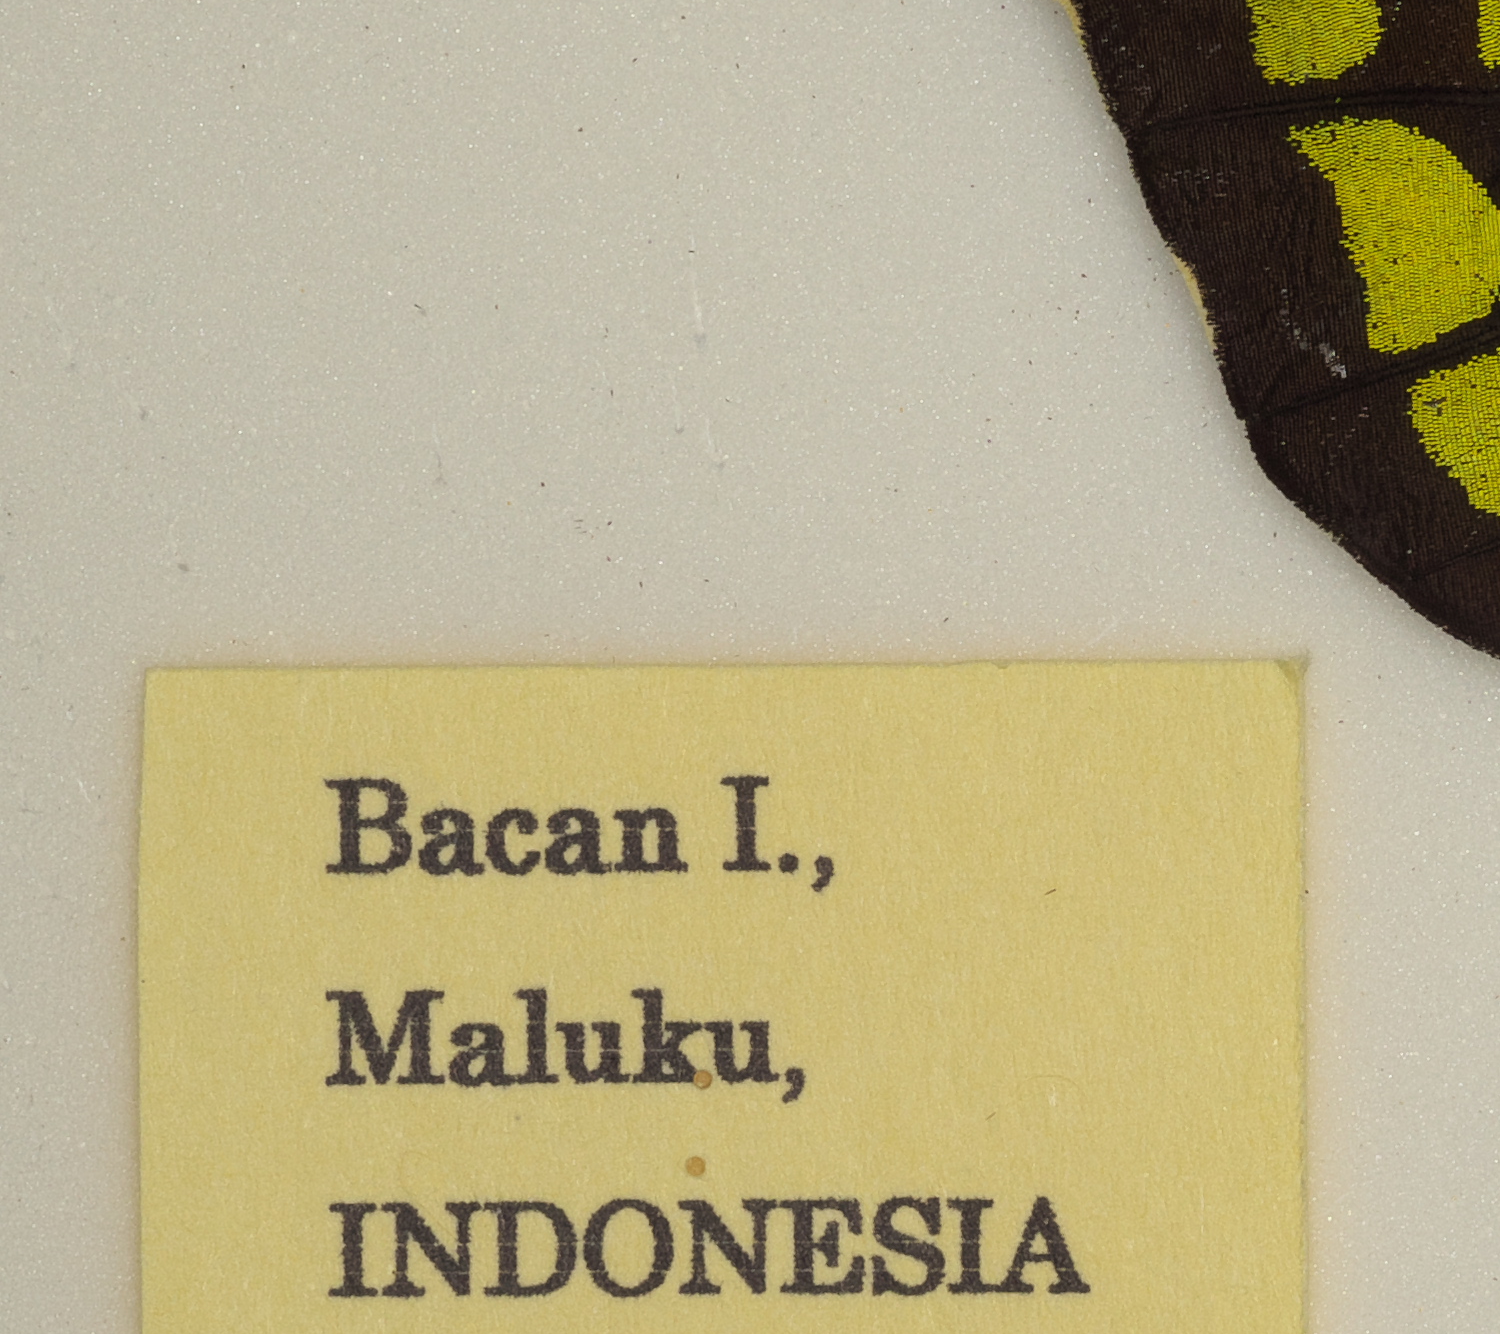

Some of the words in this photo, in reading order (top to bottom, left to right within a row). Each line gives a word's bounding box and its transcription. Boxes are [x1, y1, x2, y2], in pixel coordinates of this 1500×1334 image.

[324, 776, 689, 878] Bacan
[719, 774, 835, 893] I.,
[324, 987, 806, 1103] Maluku,
[327, 1195, 1091, 1299] INDONESIA
